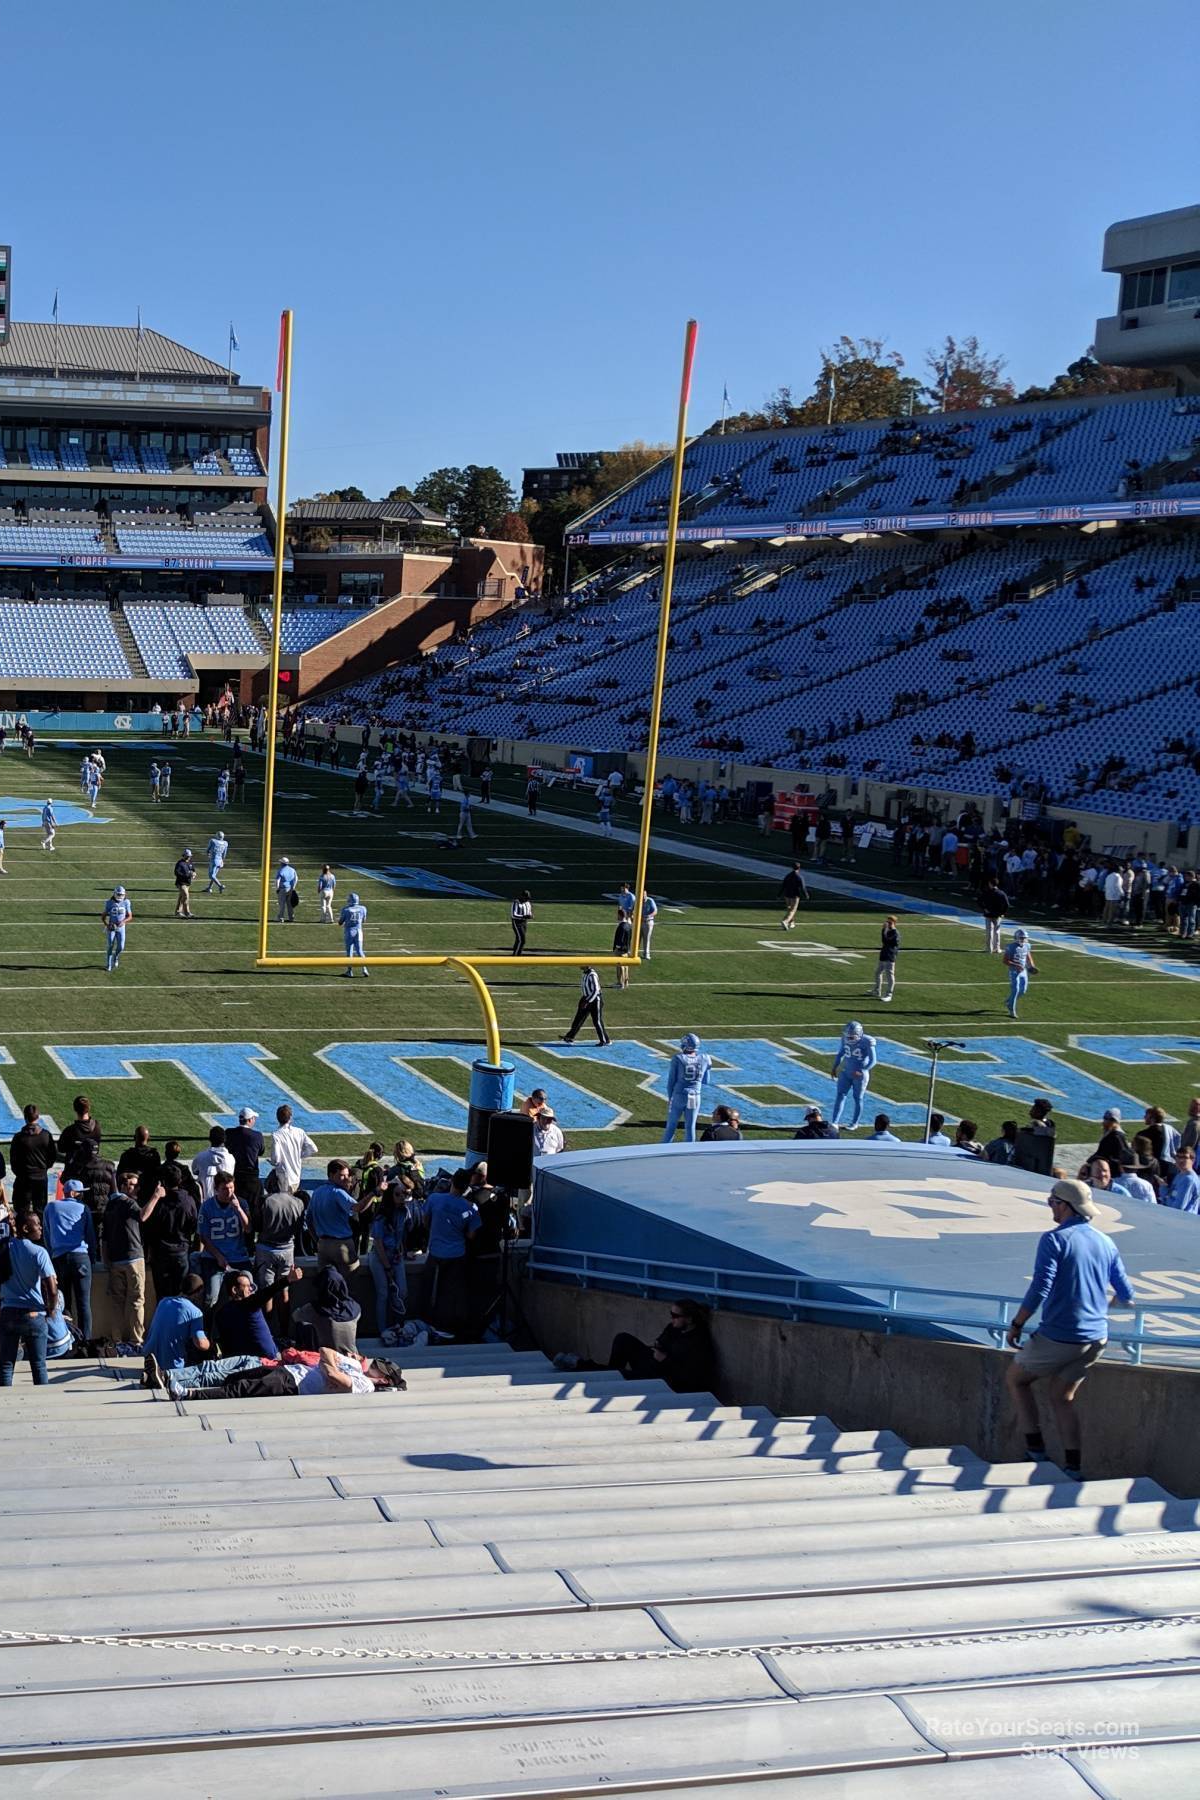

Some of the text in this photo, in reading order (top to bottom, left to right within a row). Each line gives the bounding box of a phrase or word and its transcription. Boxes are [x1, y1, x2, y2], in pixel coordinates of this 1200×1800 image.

[1051, 507, 1081, 520] JONES
[1151, 501, 1179, 514] ELLIS
[784, 522, 828, 534] 98 TAYLOR
[863, 519, 876, 530] 95
[611, 532, 646, 543] WELCOME
[648, 532, 657, 541] TO
[688, 528, 723, 539] STADIUM
[60, 555, 108, 566] 64 COOPER
[164, 558, 214, 569] 87 SEVERIN
[210, 1215, 240, 1240] 23
